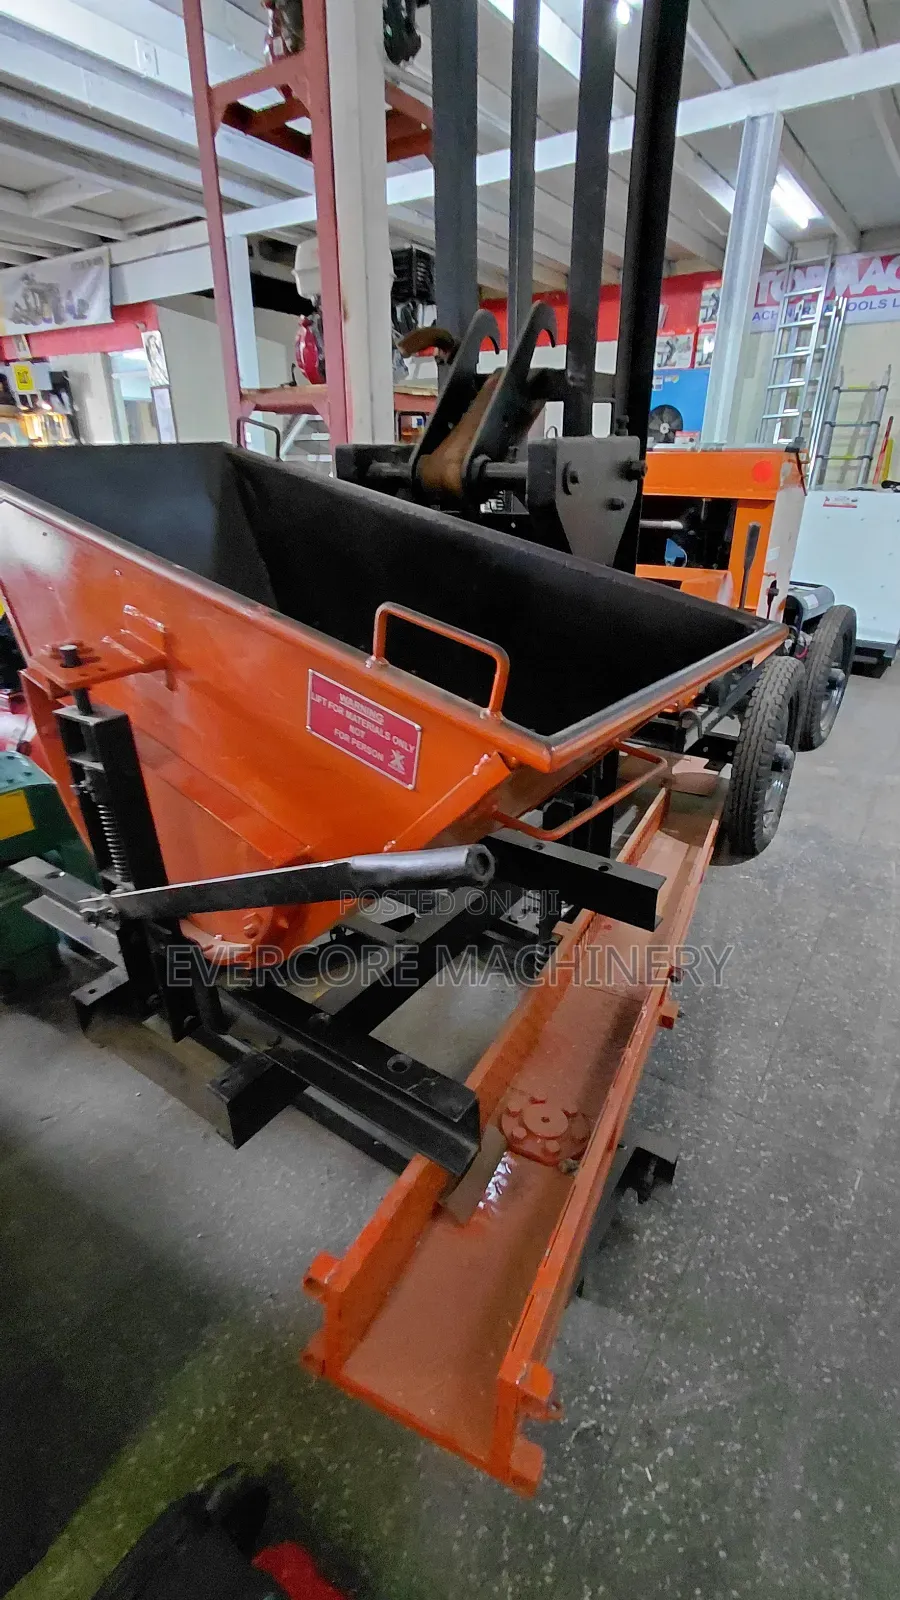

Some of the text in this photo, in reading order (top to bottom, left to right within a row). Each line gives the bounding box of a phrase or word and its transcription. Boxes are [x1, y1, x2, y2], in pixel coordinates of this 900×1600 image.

[845, 298, 888, 312] OOLS
[311, 692, 416, 753] LIFT FOR MATERIALS ONLY
[339, 692, 385, 724] WARNING
[334, 728, 384, 762] FOR PERSON
[349, 724, 366, 739] NOT
